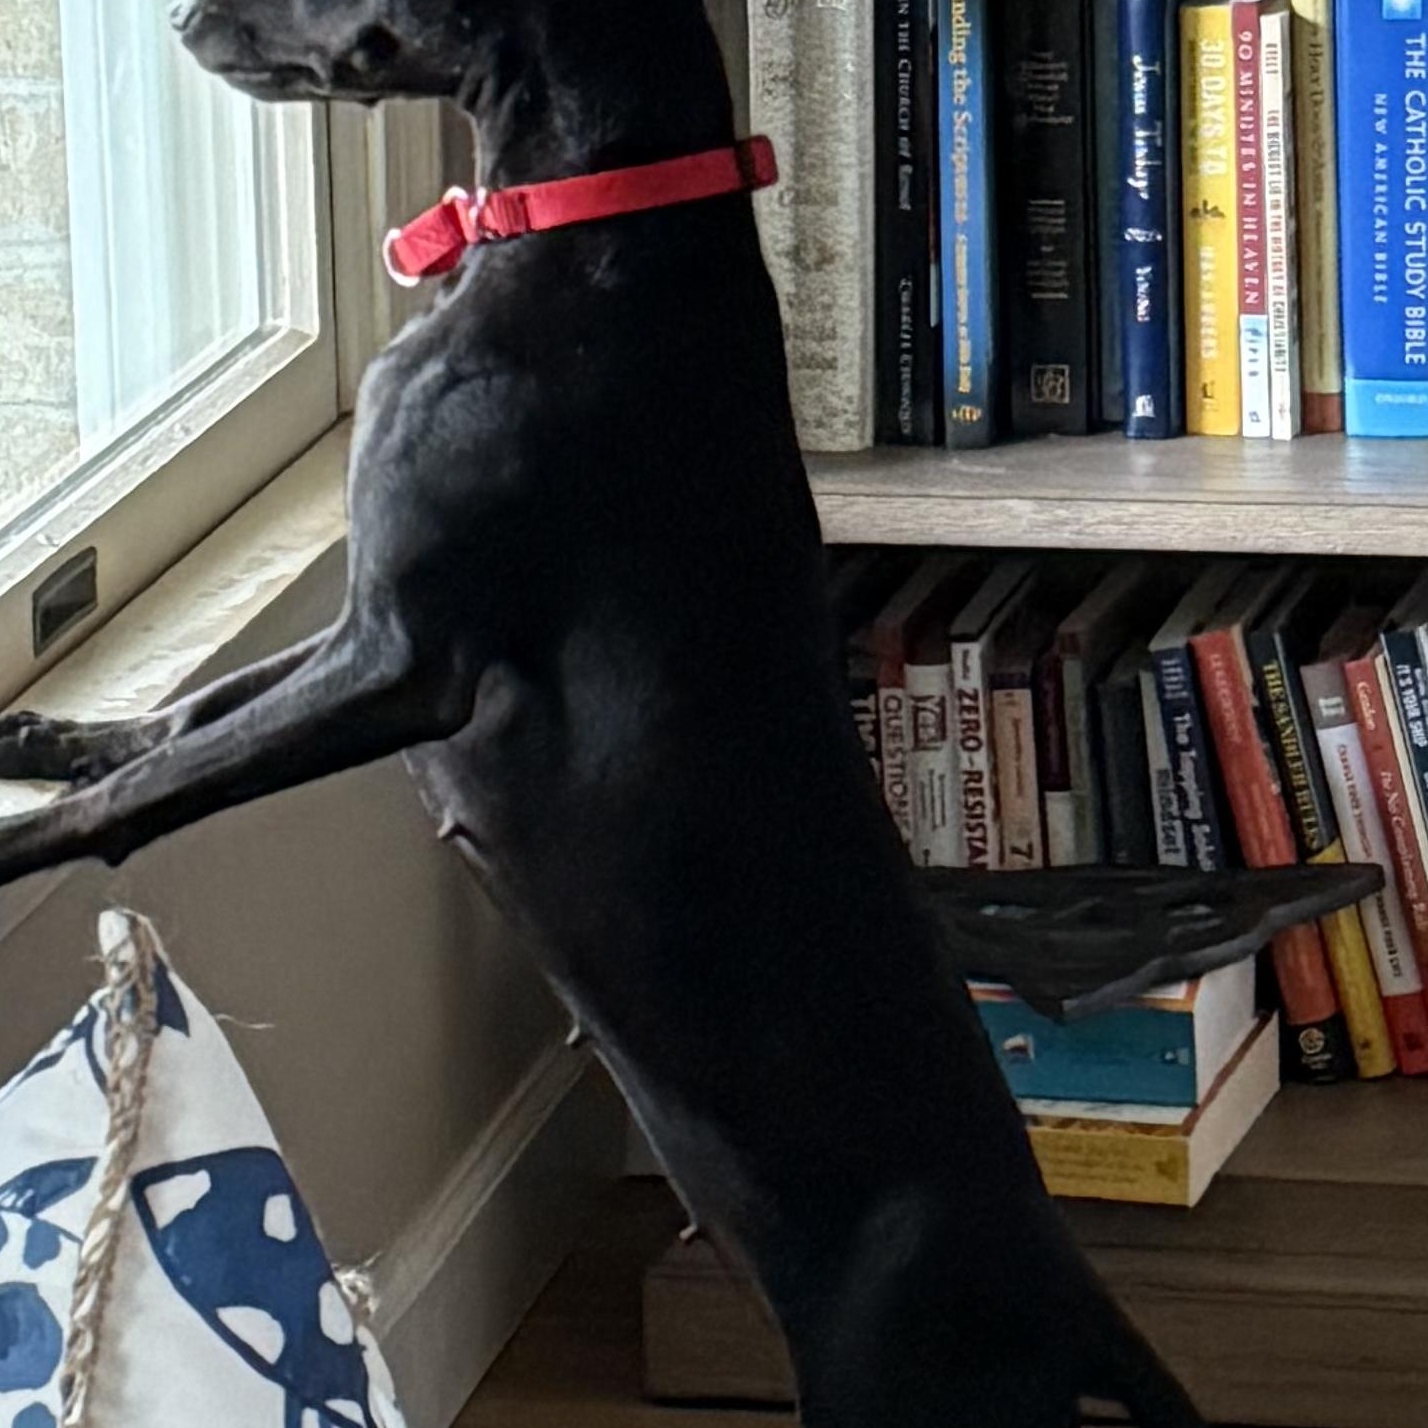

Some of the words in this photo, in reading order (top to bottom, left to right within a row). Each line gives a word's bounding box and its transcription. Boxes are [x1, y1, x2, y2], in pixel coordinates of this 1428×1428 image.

[1201, 38, 1226, 69] 30
[1237, 31, 1254, 60] 90
[1404, 32, 1427, 79] THE
[952, 70, 971, 105] the
[1201, 76, 1226, 139] DAYS
[1372, 93, 1388, 134] NEW
[1404, 90, 1427, 212] CATHOLIC
[1372, 142, 1388, 244] AMERICAN
[1372, 253, 1388, 304] BIBLE
[1403, 220, 1427, 299] STUDY
[1404, 306, 1427, 365] BIBLE
[1173, 712, 1191, 745] The
[1261, 661, 1283, 701] THE
[1273, 702, 1306, 788] SANDLER
[1292, 788, 1320, 850] RULES
[1156, 769, 1179, 854] Mindset
[1176, 751, 1203, 818] Tapping
[1010, 840, 1033, 860] 7
